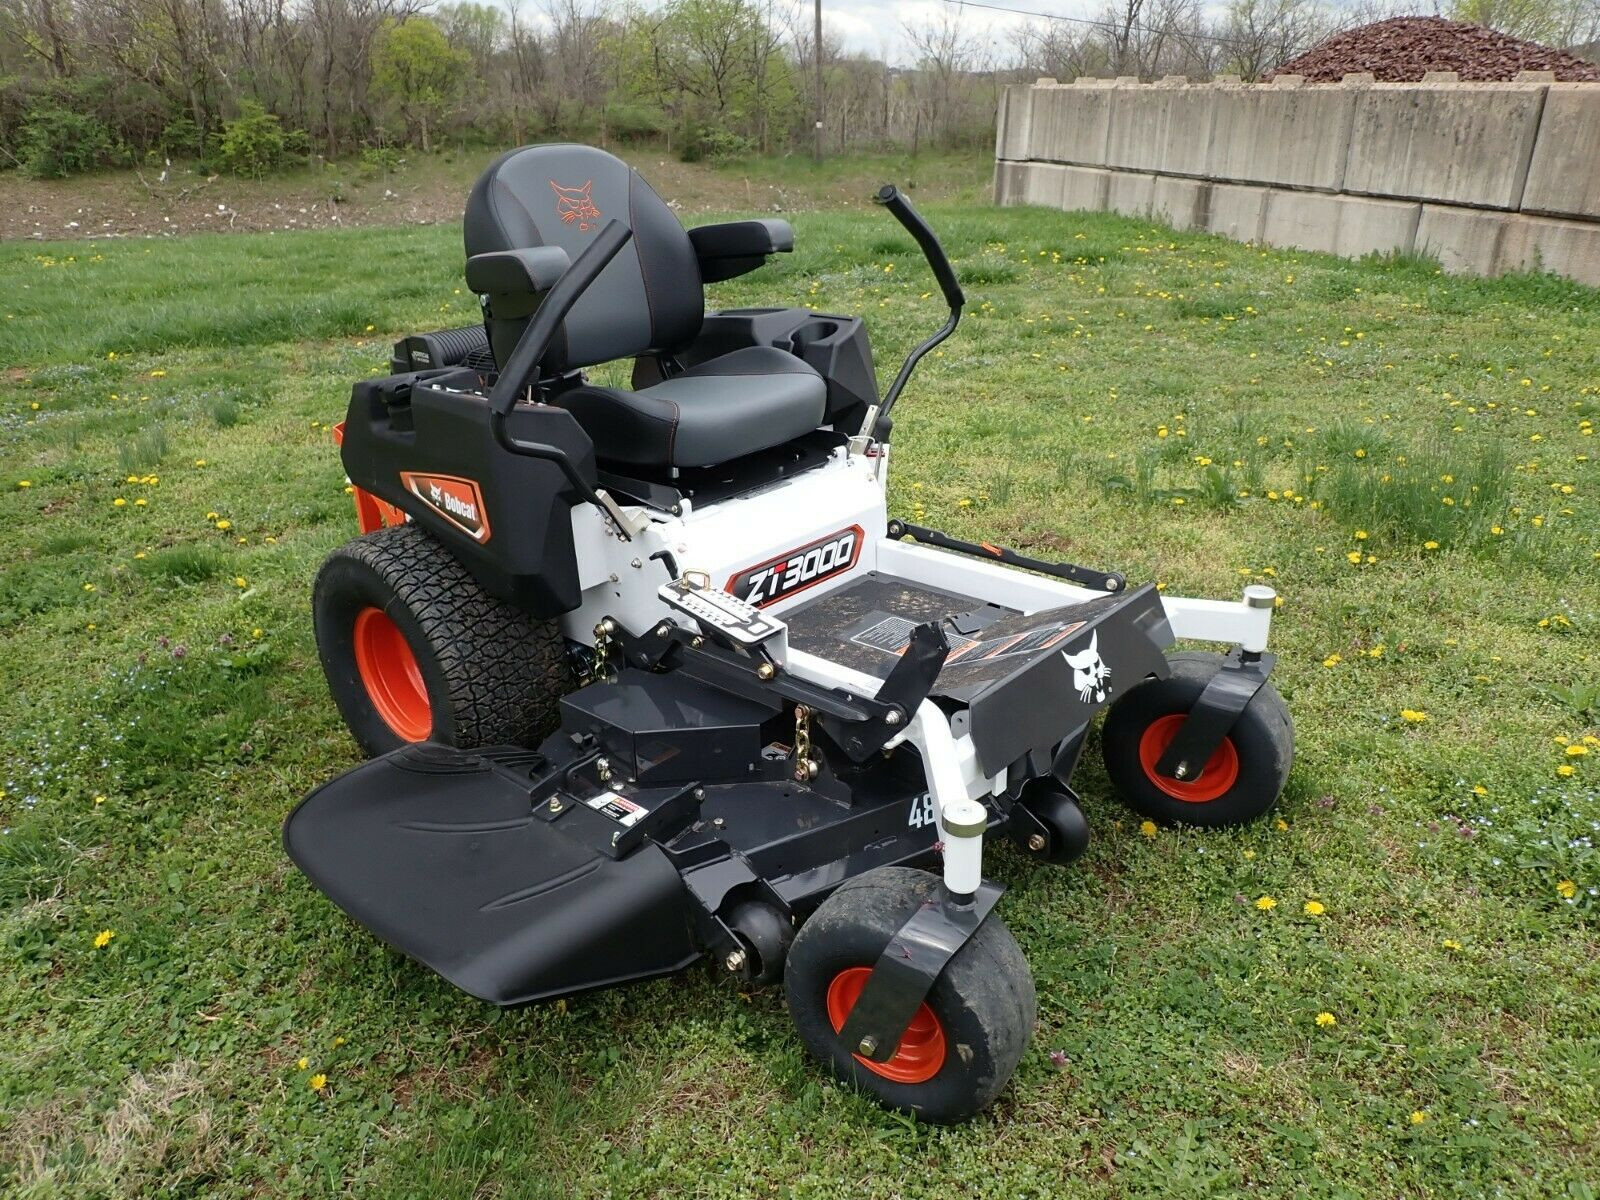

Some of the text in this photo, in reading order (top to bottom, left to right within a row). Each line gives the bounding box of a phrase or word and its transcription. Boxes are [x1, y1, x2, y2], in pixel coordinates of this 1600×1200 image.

[444, 492, 476, 520] Bobcat
[744, 533, 855, 604] ZT3000
[909, 793, 936, 828] 48
